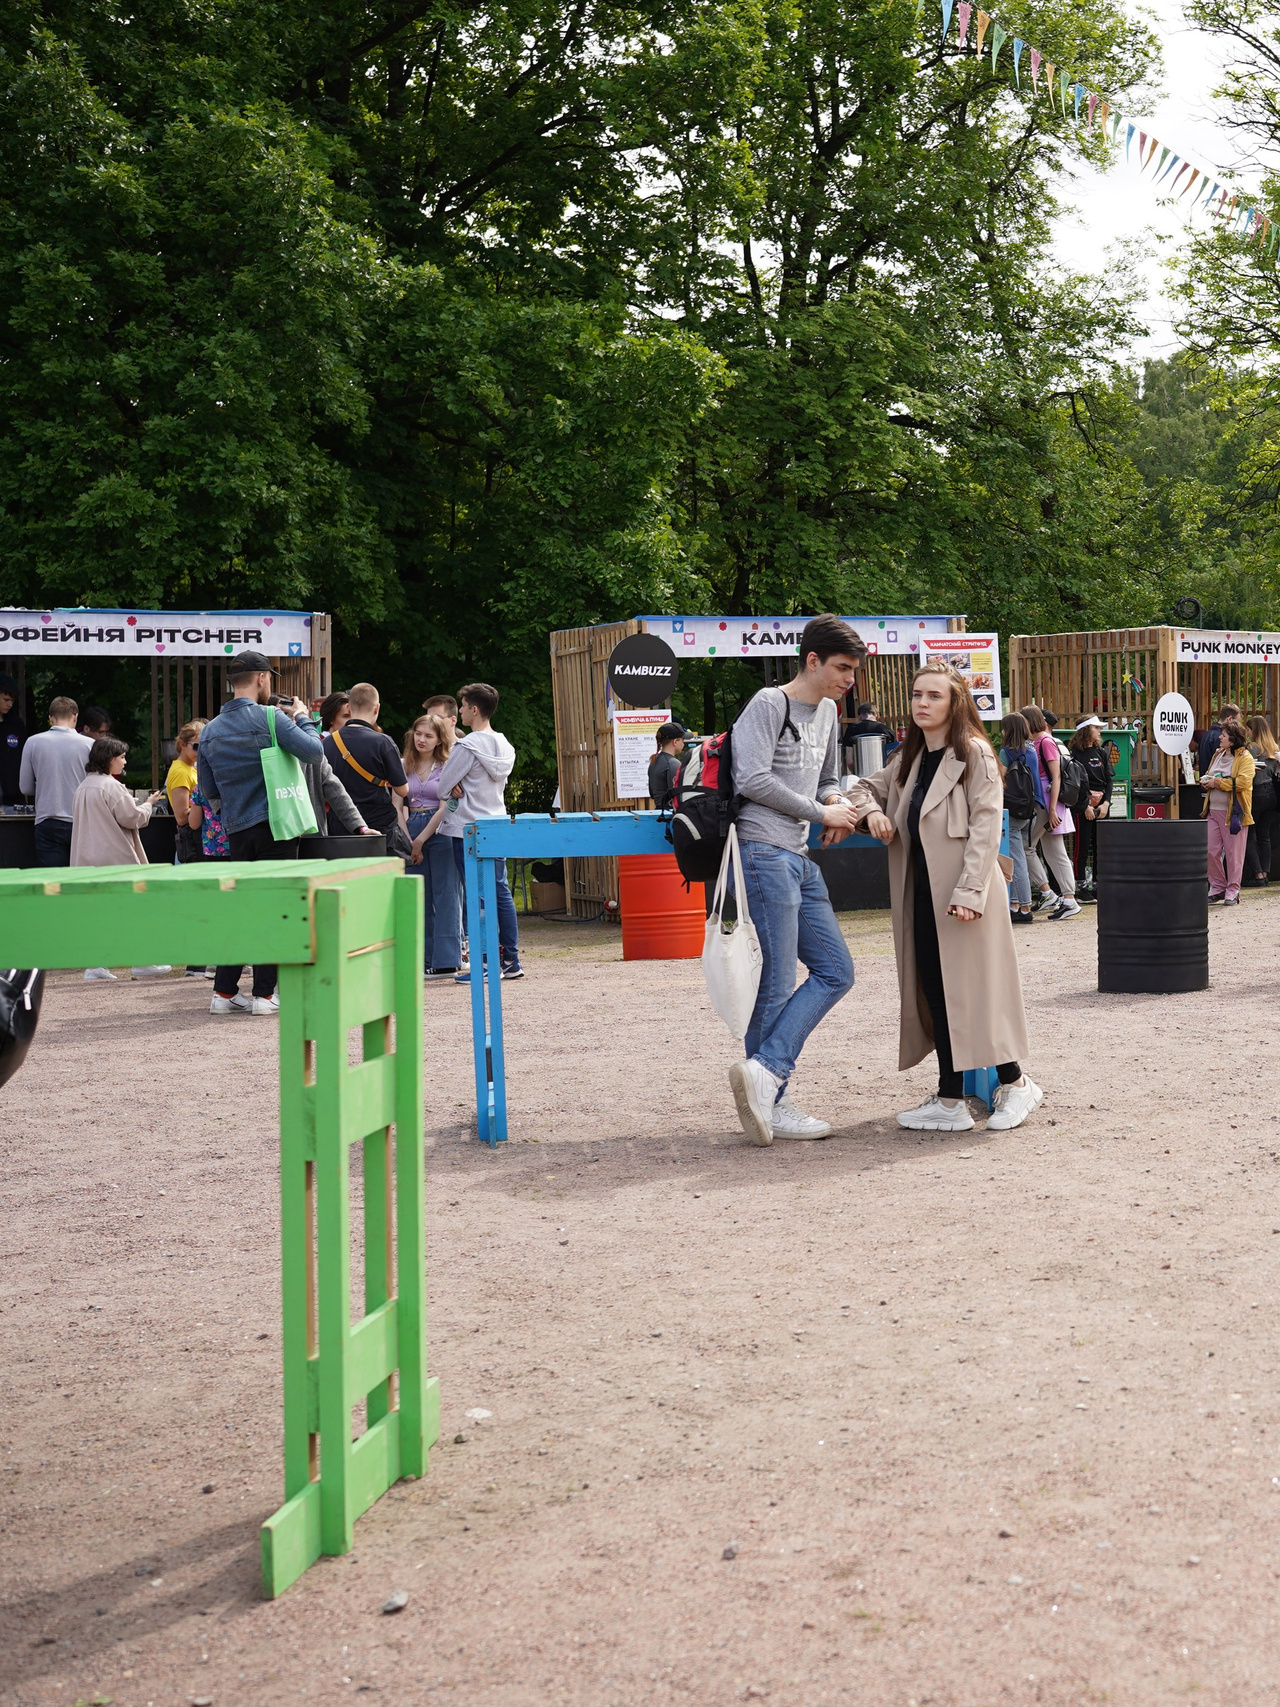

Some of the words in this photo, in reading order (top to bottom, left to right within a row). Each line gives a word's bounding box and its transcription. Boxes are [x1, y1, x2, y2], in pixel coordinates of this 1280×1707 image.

[135, 628, 263, 644] PITCHER
[1181, 641, 1221, 653] PUNK
[1224, 642, 1280, 655] MONKEY
[614, 664, 672, 677] KAMBUZZ
[1160, 711, 1188, 724] PUNK
[1160, 724, 1188, 732] MONKEY
